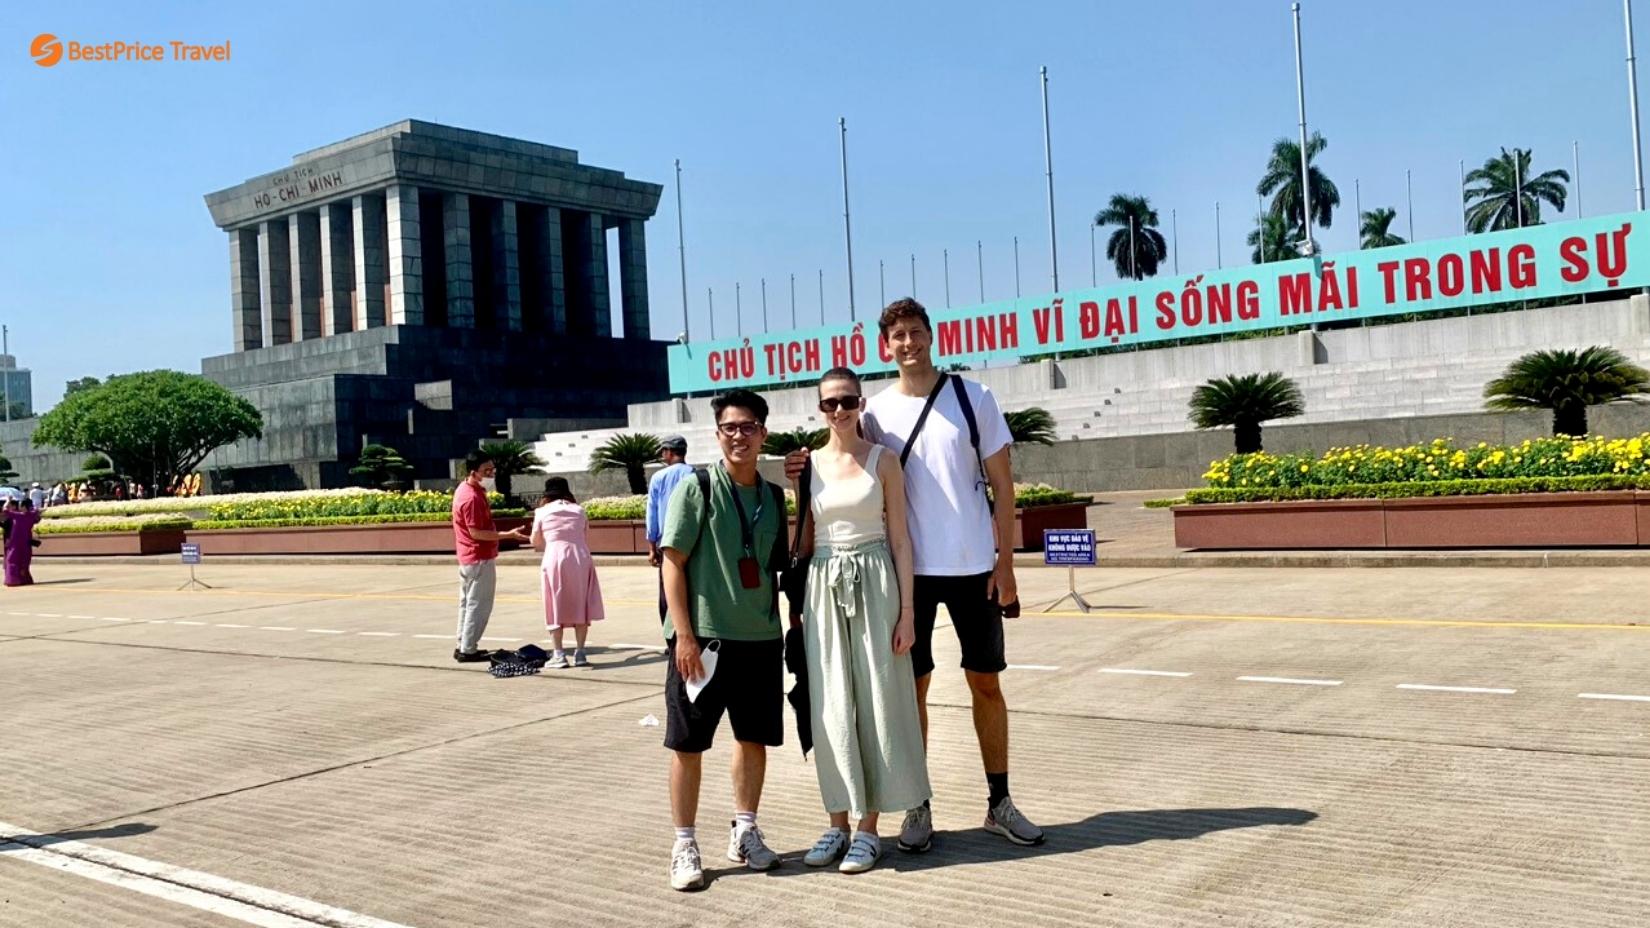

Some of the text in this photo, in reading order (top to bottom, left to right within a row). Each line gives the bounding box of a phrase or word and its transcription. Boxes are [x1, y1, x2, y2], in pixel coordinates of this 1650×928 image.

[708, 338, 755, 382] CHỦ
[764, 338, 820, 381] TỊCH
[831, 321, 866, 369] HỒ
[937, 311, 1019, 357] MINH
[1032, 297, 1064, 345] VĨ
[1079, 294, 1139, 343] ĐẠI
[1155, 274, 1260, 330] SỐNG
[1278, 260, 1359, 316] MÃI
[1377, 243, 1537, 304] TRONG
[1559, 222, 1632, 287] SỰ
